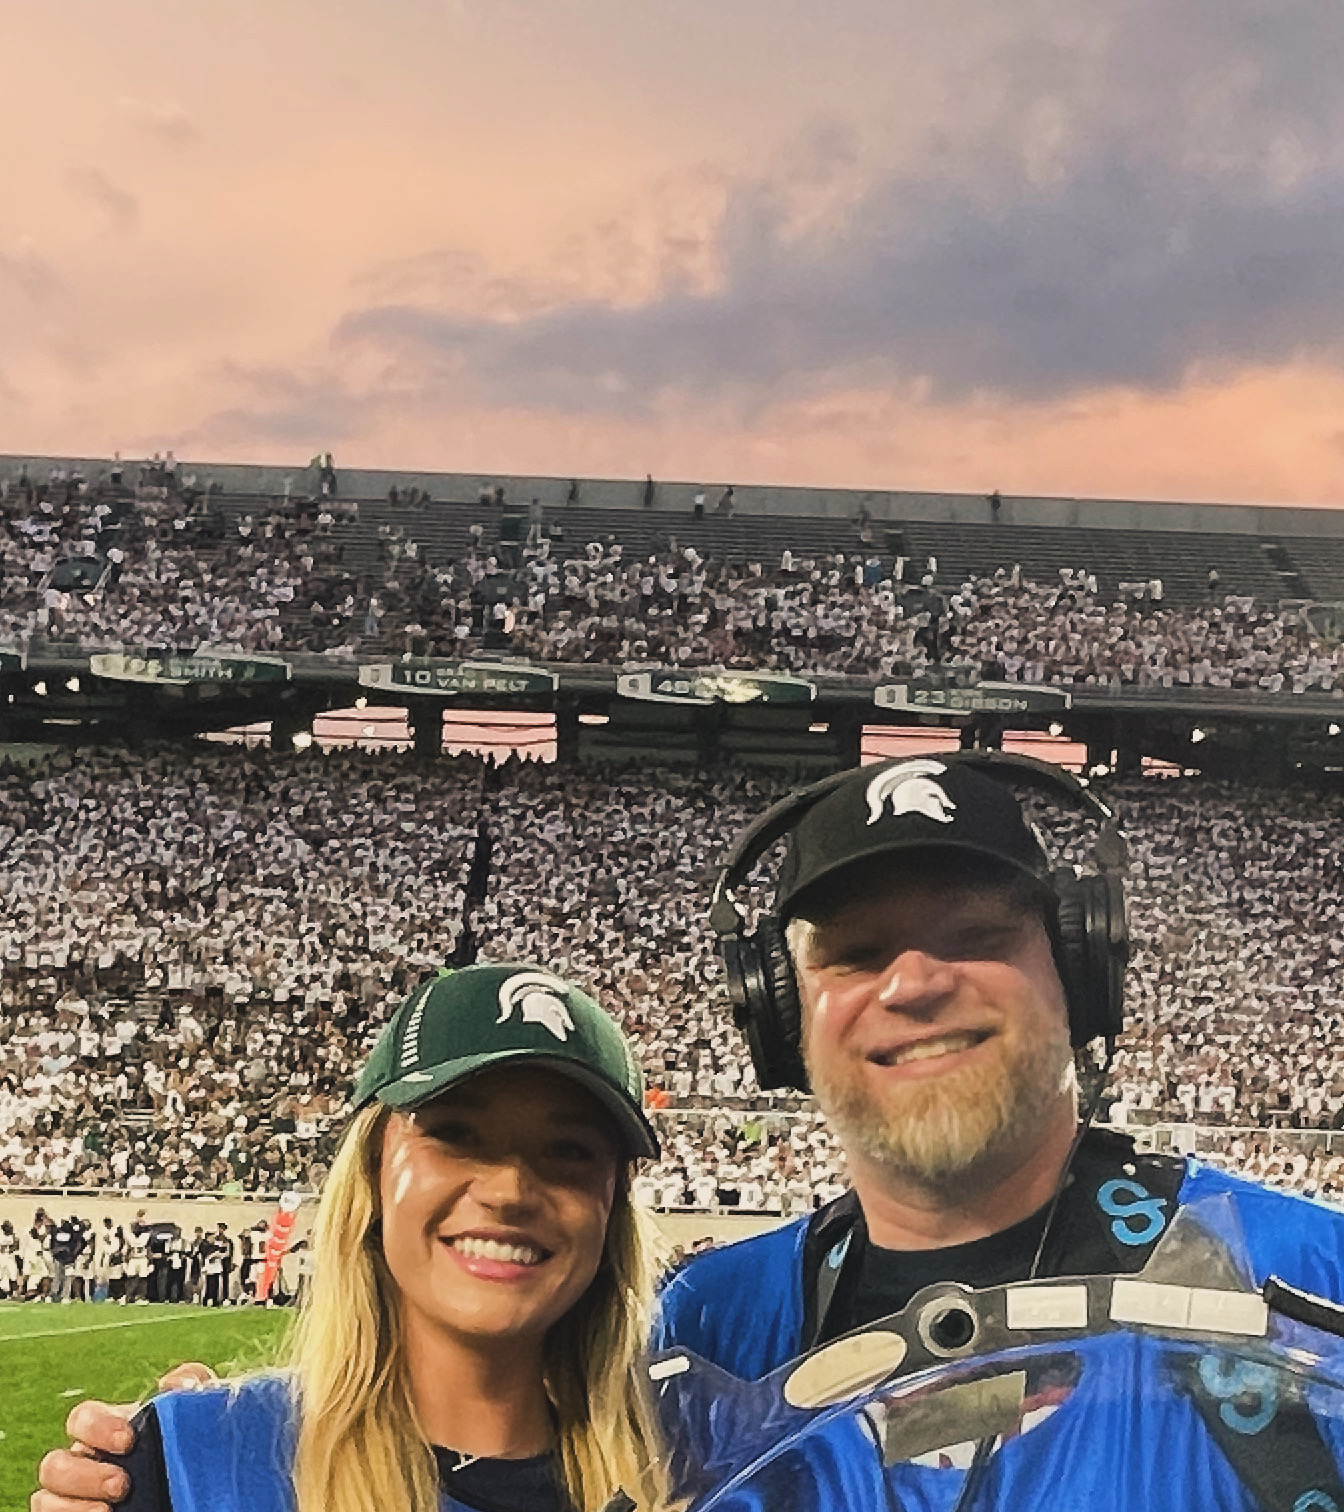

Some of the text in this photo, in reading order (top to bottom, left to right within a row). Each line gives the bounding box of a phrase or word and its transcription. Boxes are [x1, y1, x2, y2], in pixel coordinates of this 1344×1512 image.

[403, 669, 432, 684] 10
[436, 677, 476, 689] VAN
[481, 678, 531, 692] PELT
[914, 689, 947, 704] 23
